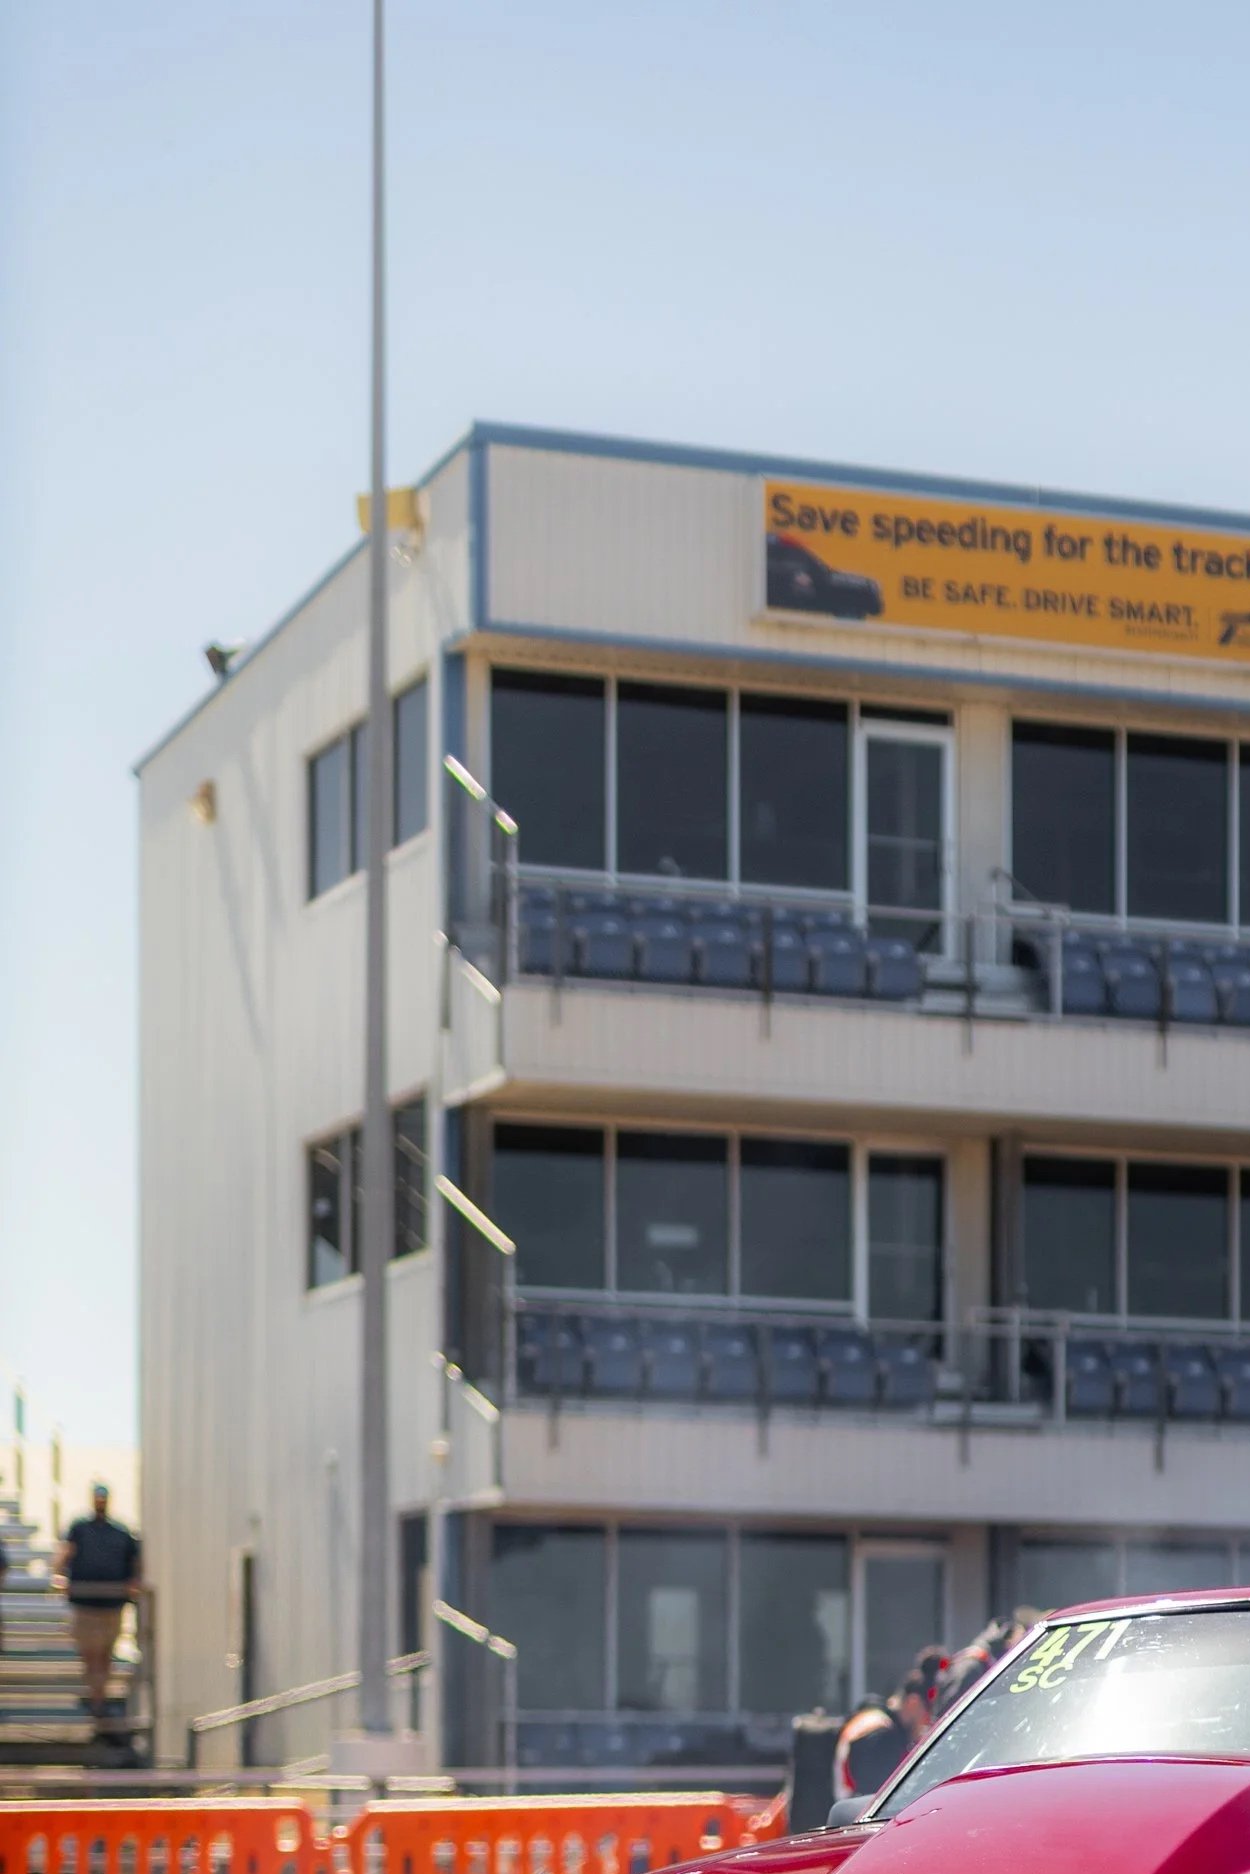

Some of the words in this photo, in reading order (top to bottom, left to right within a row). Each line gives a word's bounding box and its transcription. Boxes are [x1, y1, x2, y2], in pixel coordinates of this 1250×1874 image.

[771, 493, 859, 537] Save
[872, 512, 1032, 565] speeding
[1044, 523, 1092, 561] for
[1104, 532, 1162, 570] the
[903, 575, 935, 599] BE
[944, 579, 1016, 609] SAFE.
[1024, 587, 1100, 617] DRIVE
[1109, 596, 1199, 627] SMART.
[1029, 1619, 1132, 1668] 471
[1009, 1663, 1073, 1693] SC
